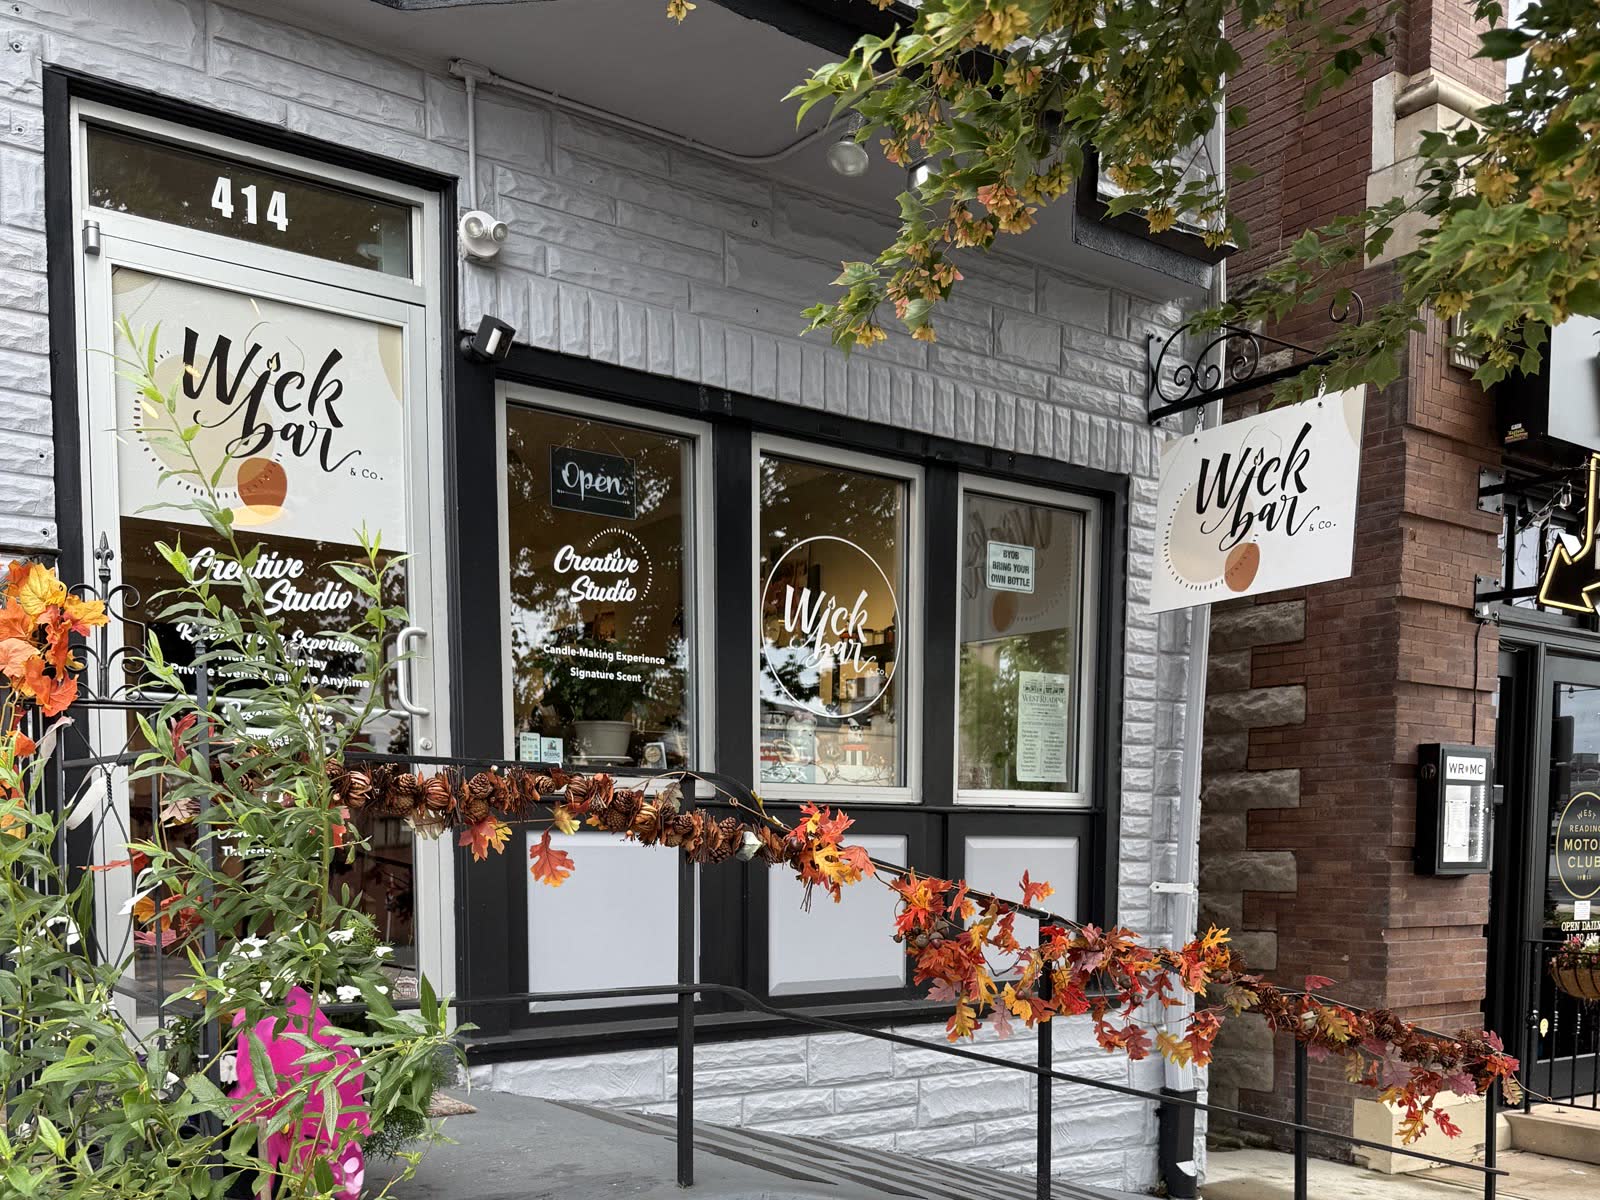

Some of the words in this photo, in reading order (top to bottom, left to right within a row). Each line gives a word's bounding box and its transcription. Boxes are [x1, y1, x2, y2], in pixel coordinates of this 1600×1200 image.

[211, 176, 289, 232] 414
[182, 326, 344, 430] Wick
[225, 420, 362, 473] bar
[561, 461, 626, 502] Open
[1195, 421, 1313, 515] Wick
[1218, 494, 1321, 552] bar
[553, 544, 640, 574] Creative
[992, 560, 1012, 572] BRING
[1013, 563, 1030, 575] YOUR
[1002, 549, 1020, 560] BYOB
[569, 574, 638, 602] Studio
[990, 573, 1007, 585] OWN
[1007, 575, 1031, 588] BOTTLE
[263, 578, 353, 616] Studio
[784, 583, 869, 644] Wick
[291, 629, 366, 656] Experien
[543, 643, 614, 662] Candle-Making
[616, 650, 666, 666] Experience
[806, 638, 877, 674] bar
[171, 662, 215, 677] Prive
[570, 667, 615, 681] Signature
[616, 672, 642, 683] Scent
[1576, 809, 1597, 821] WEST
[1564, 838, 1600, 851] MOTO
[1567, 855, 1600, 869] CLUB
[1561, 921, 1580, 932] OPEN
